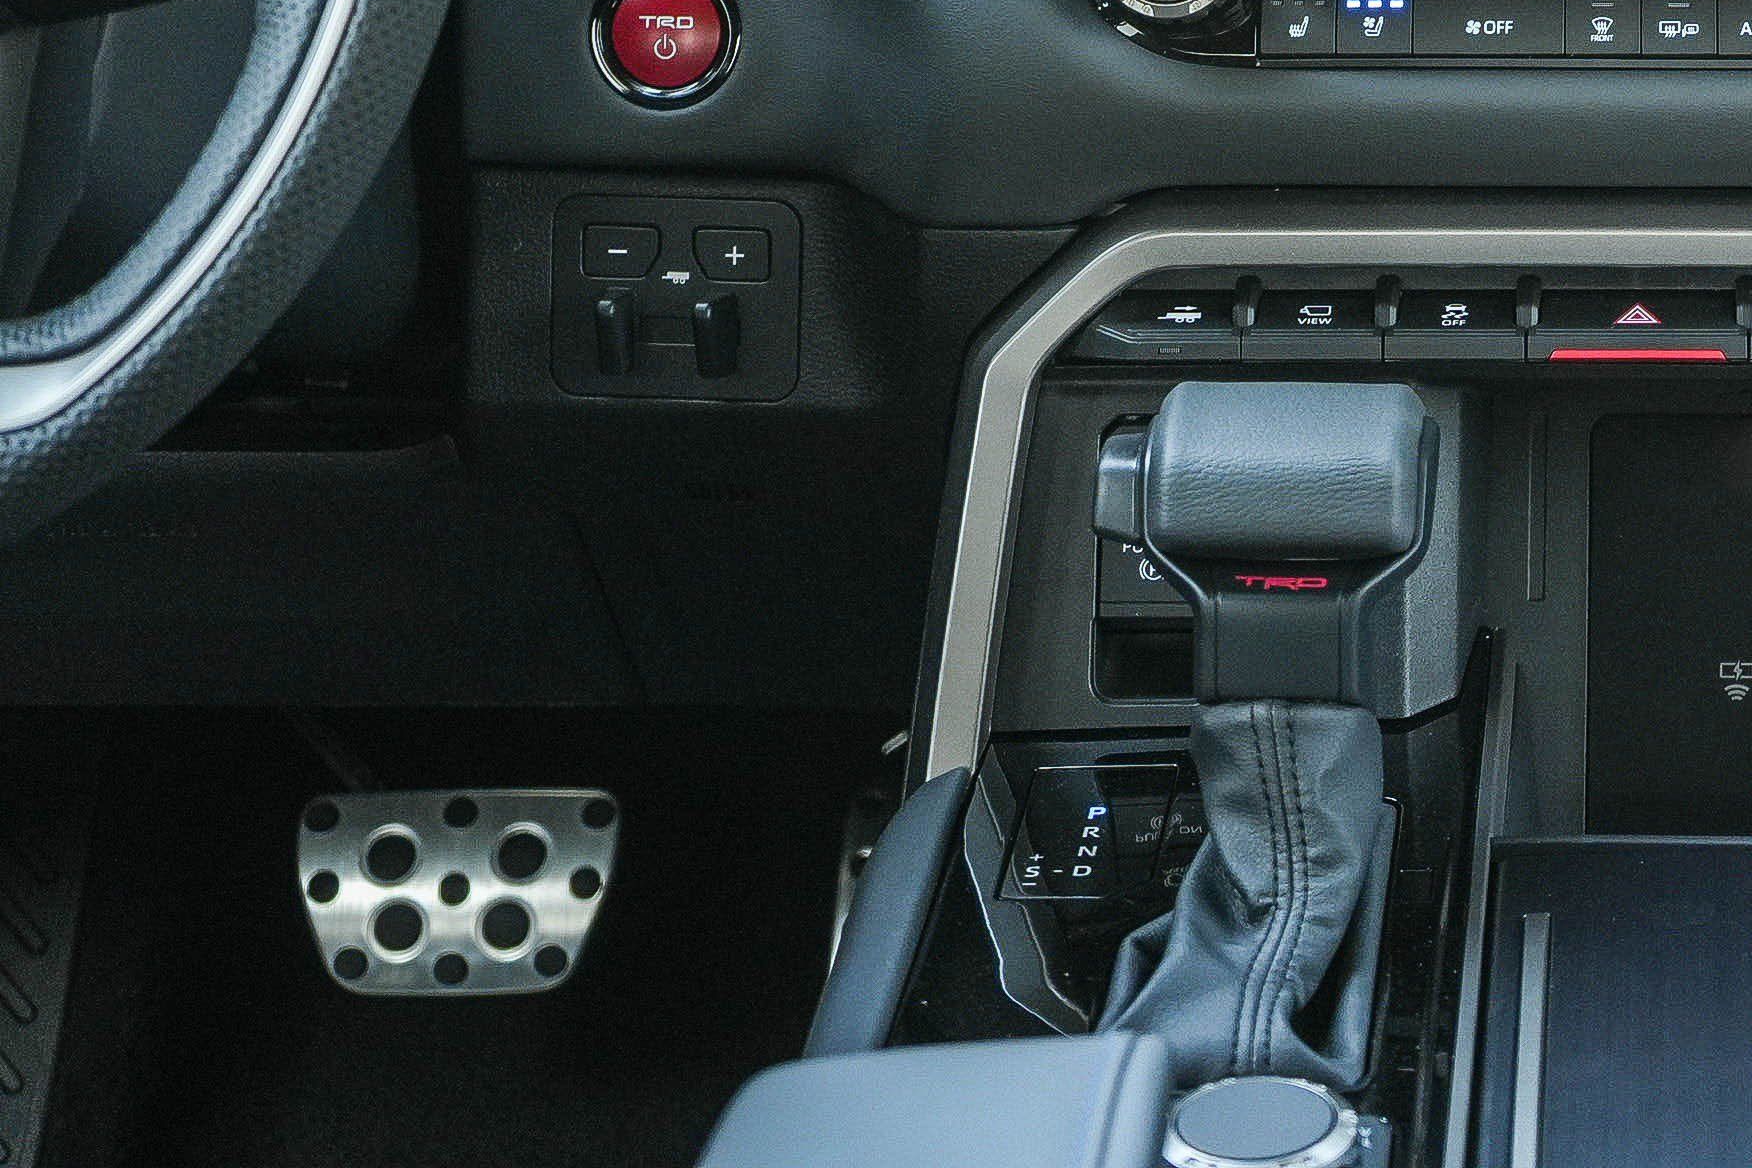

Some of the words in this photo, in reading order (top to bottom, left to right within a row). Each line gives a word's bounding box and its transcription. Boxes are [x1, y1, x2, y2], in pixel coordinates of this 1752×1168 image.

[638, 15, 694, 29] TRD
[1483, 19, 1514, 36] OFF
[1590, 34, 1614, 42] FRONT
[1297, 317, 1332, 325] VIEW
[1441, 318, 1467, 327] OFF
[1235, 575, 1329, 591] TRD
[1087, 806, 1107, 820] P
[1082, 826, 1100, 838] R
[1077, 845, 1097, 857] N
[1024, 865, 1041, 878] S
[1072, 865, 1092, 877] D
